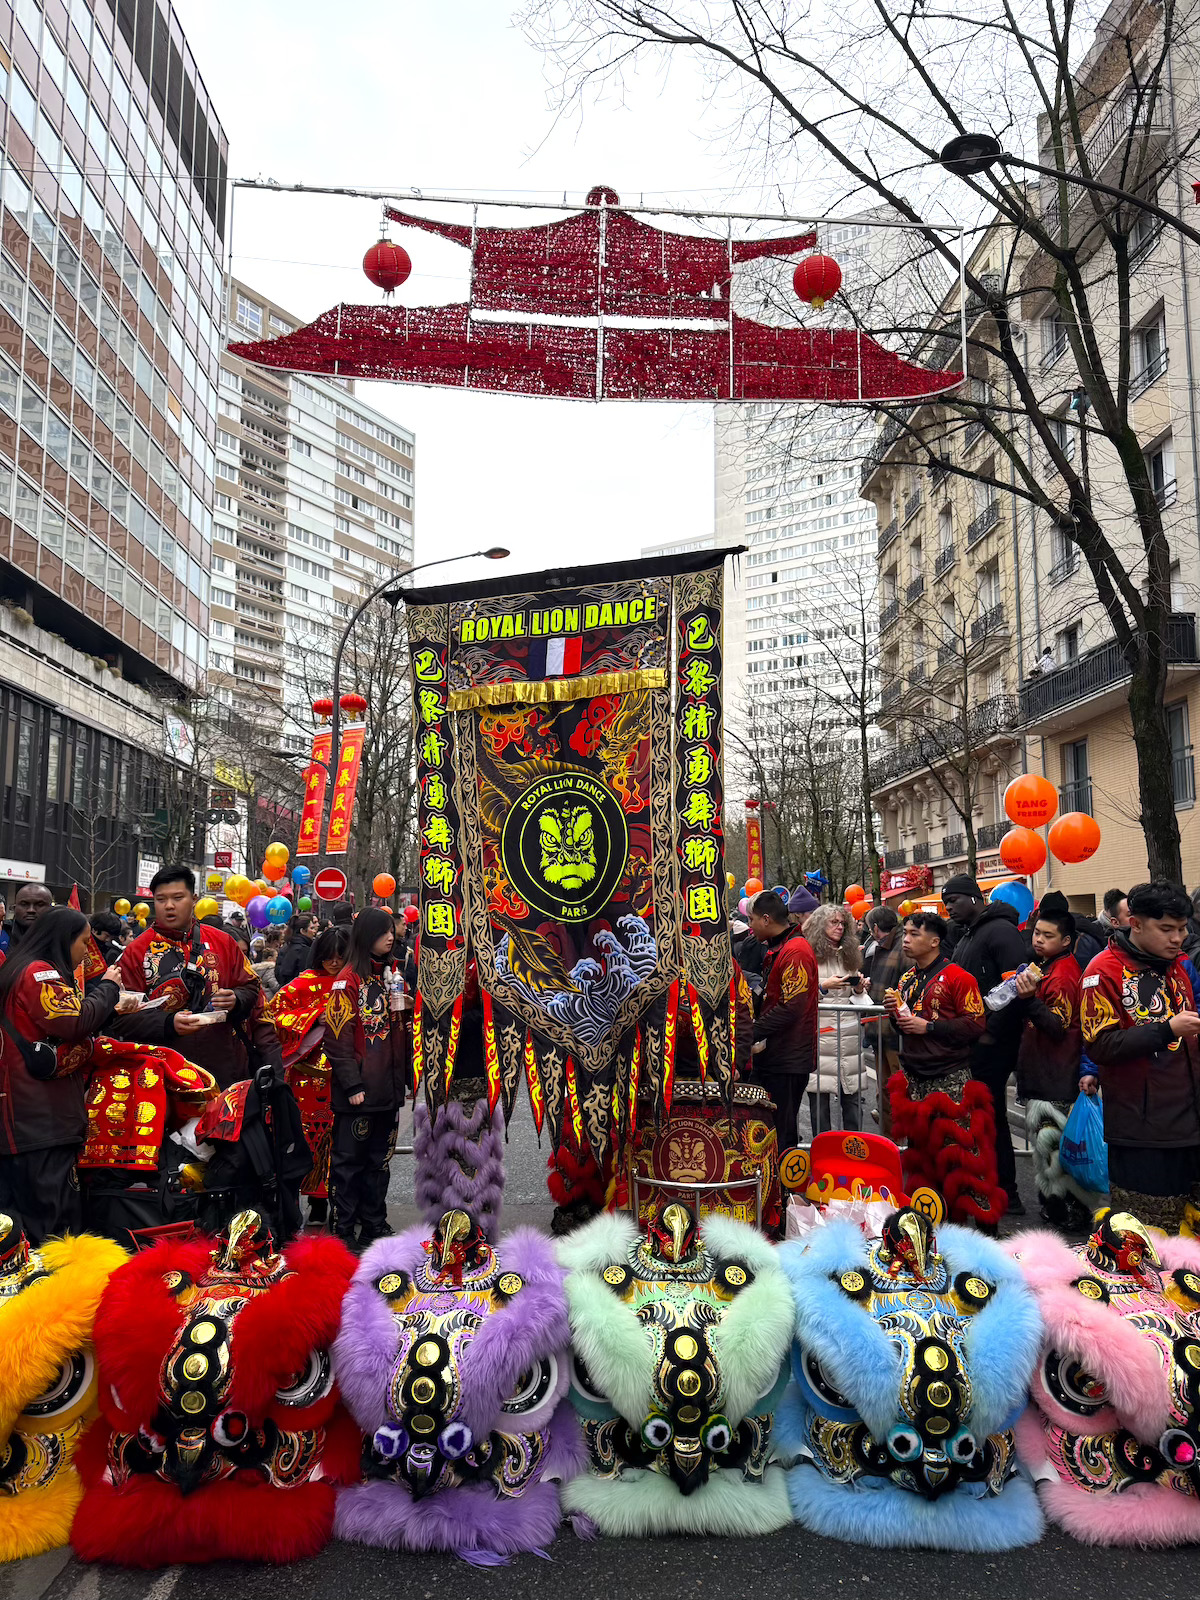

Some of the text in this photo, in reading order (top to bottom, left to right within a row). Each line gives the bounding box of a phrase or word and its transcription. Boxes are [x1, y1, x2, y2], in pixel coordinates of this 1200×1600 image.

[460, 597, 656, 643] ROYAL LION DANCE
[682, 616, 719, 922] 巴黎精勇舞獅團
[331, 745, 355, 836] 國泰民安
[414, 650, 455, 938] 巴黎精勇舞獅團
[521, 785, 553, 811] ROYAL
[576, 779, 607, 804] DANCE
[1016, 799, 1048, 809] TANG
[216, 856, 230, 864] SFR
[561, 905, 588, 917] PARIS
[661, 1123, 679, 1139] ROAL
[695, 1122, 715, 1139] DANCE
